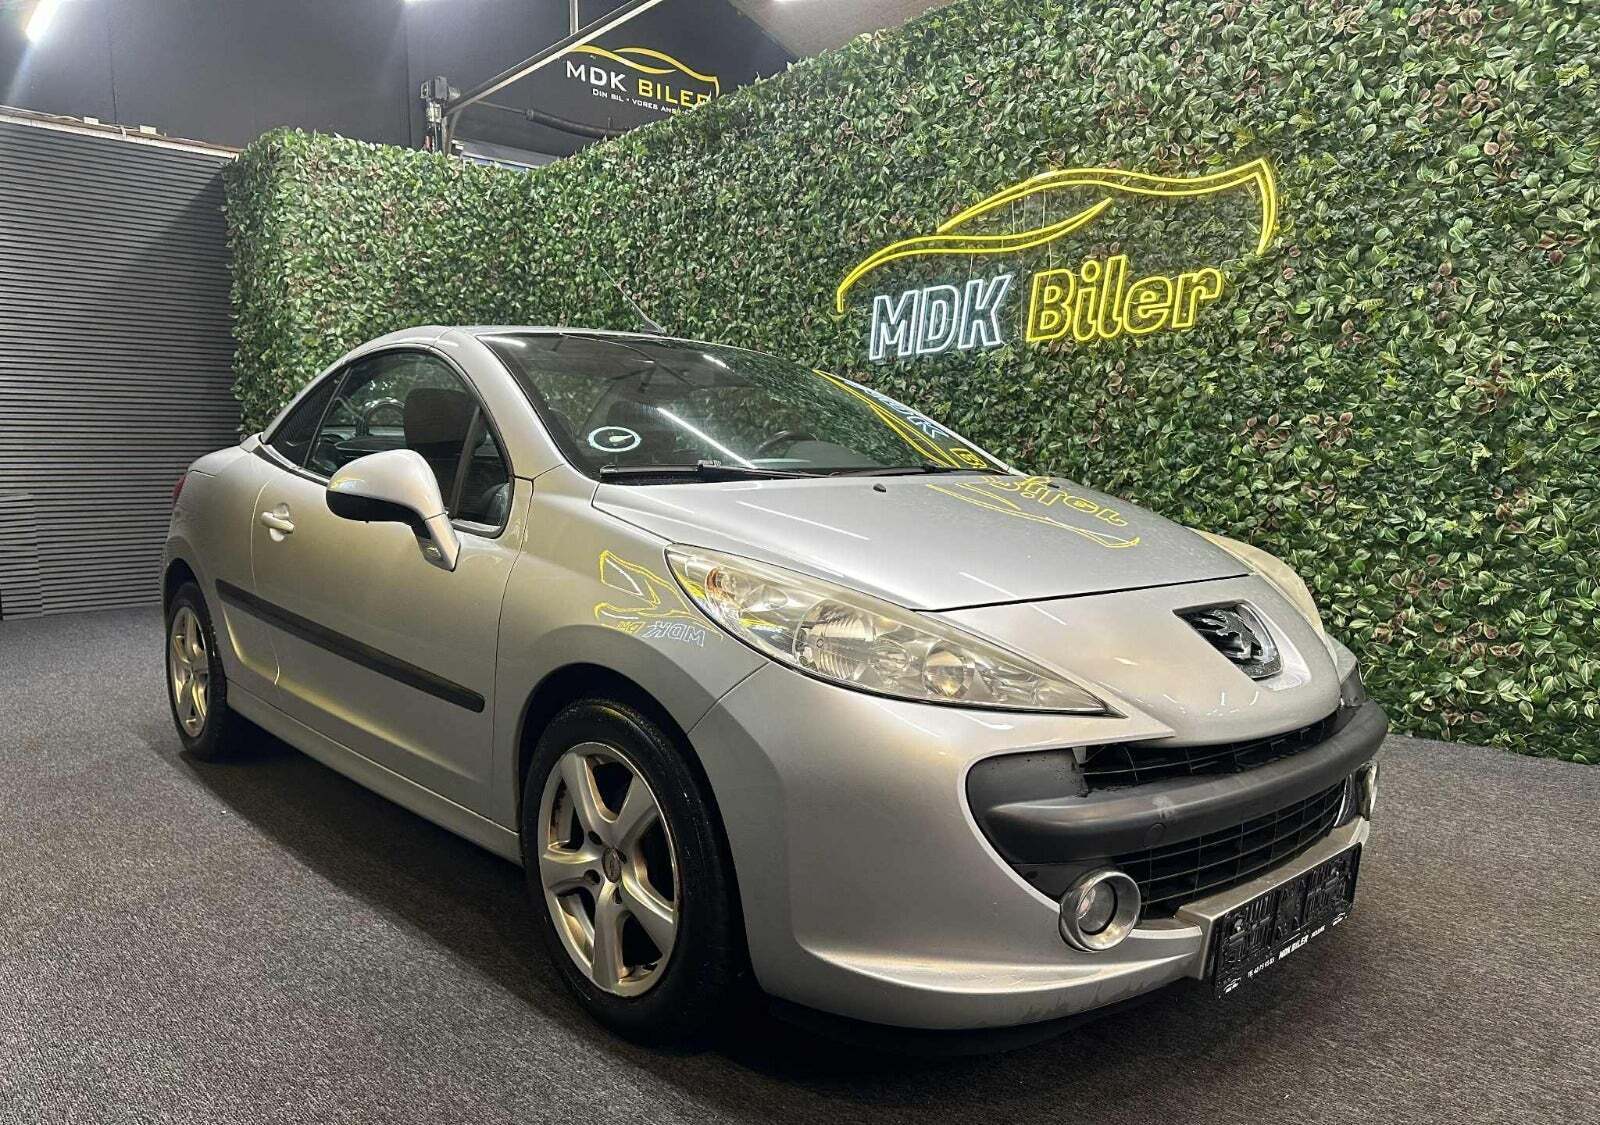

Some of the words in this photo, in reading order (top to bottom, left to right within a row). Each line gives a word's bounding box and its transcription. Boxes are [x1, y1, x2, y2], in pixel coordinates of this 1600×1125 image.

[566, 60, 627, 92] MDK
[869, 273, 1014, 363] MDK
[1026, 254, 1224, 343] Biler
